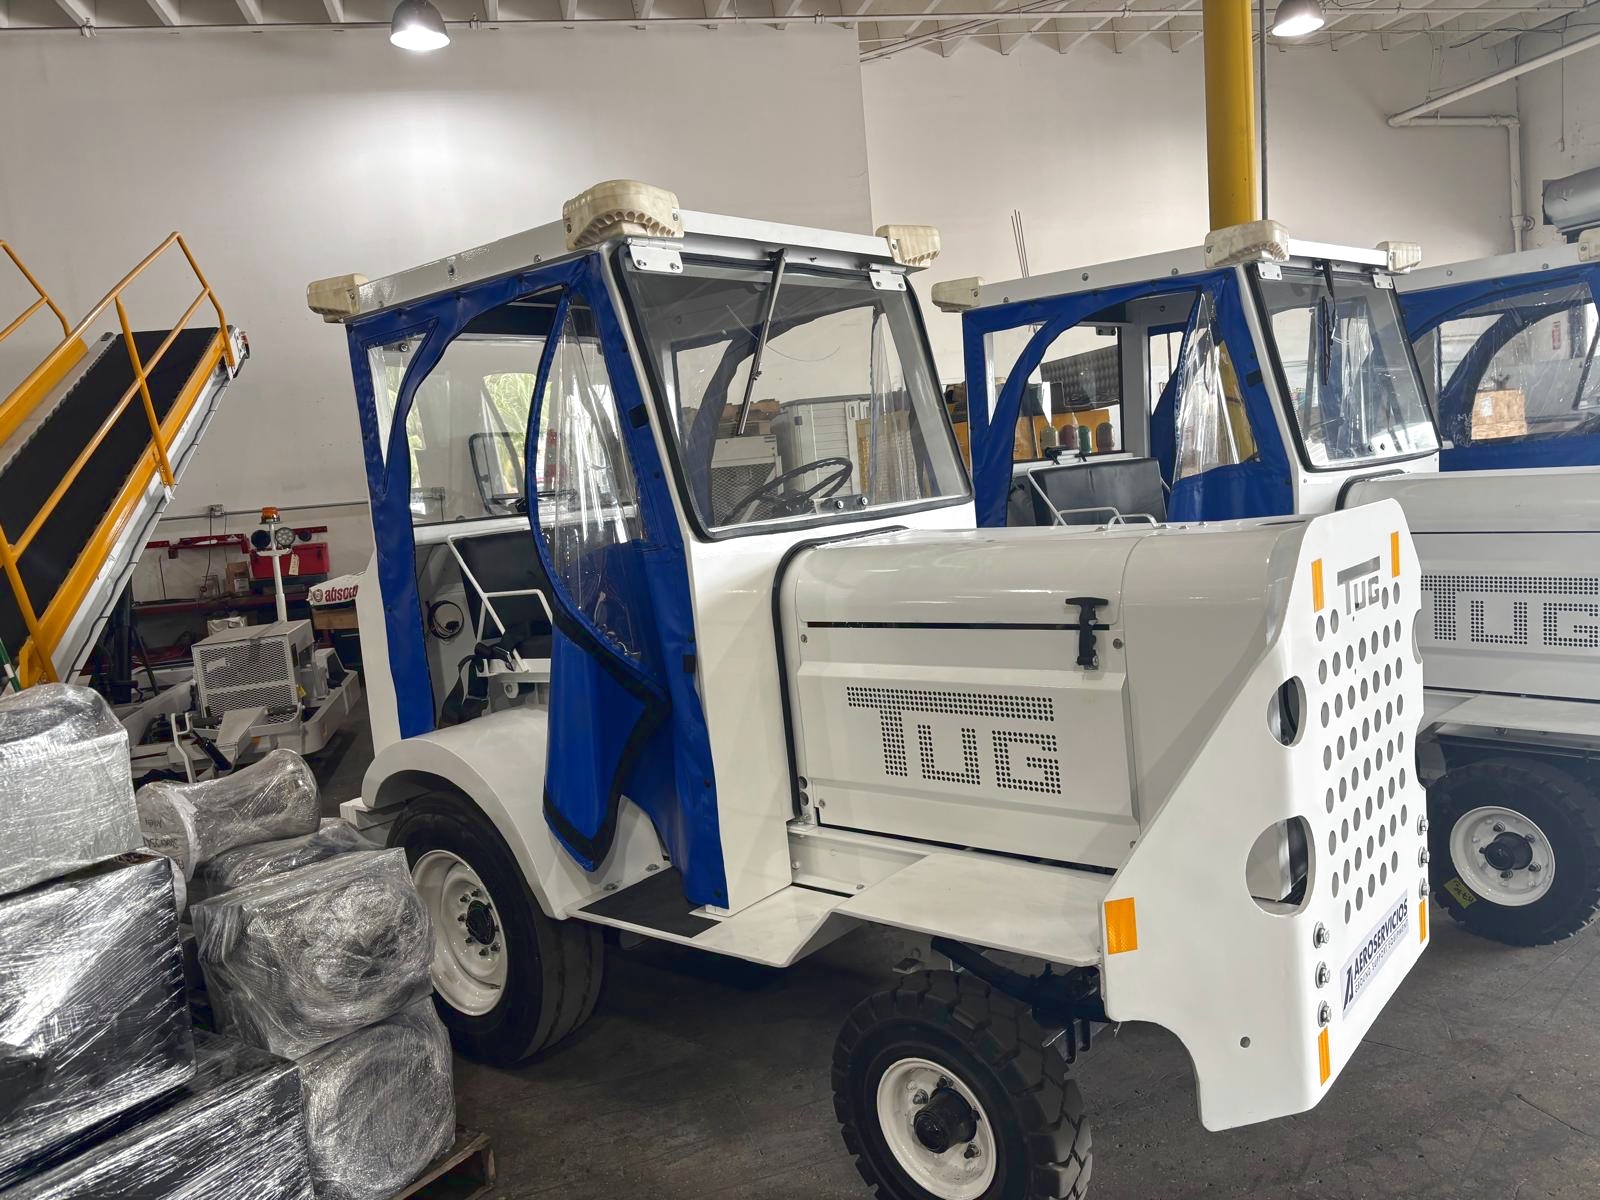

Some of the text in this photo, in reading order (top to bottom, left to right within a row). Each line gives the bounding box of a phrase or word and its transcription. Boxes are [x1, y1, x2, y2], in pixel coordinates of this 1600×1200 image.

[1337, 556, 1380, 615] TUG
[1421, 575, 1600, 648] TUG
[846, 686, 1062, 795] TUG
[1354, 898, 1408, 980] AEROSERVICIOS
[1372, 943, 1388, 971] SUPPORT
